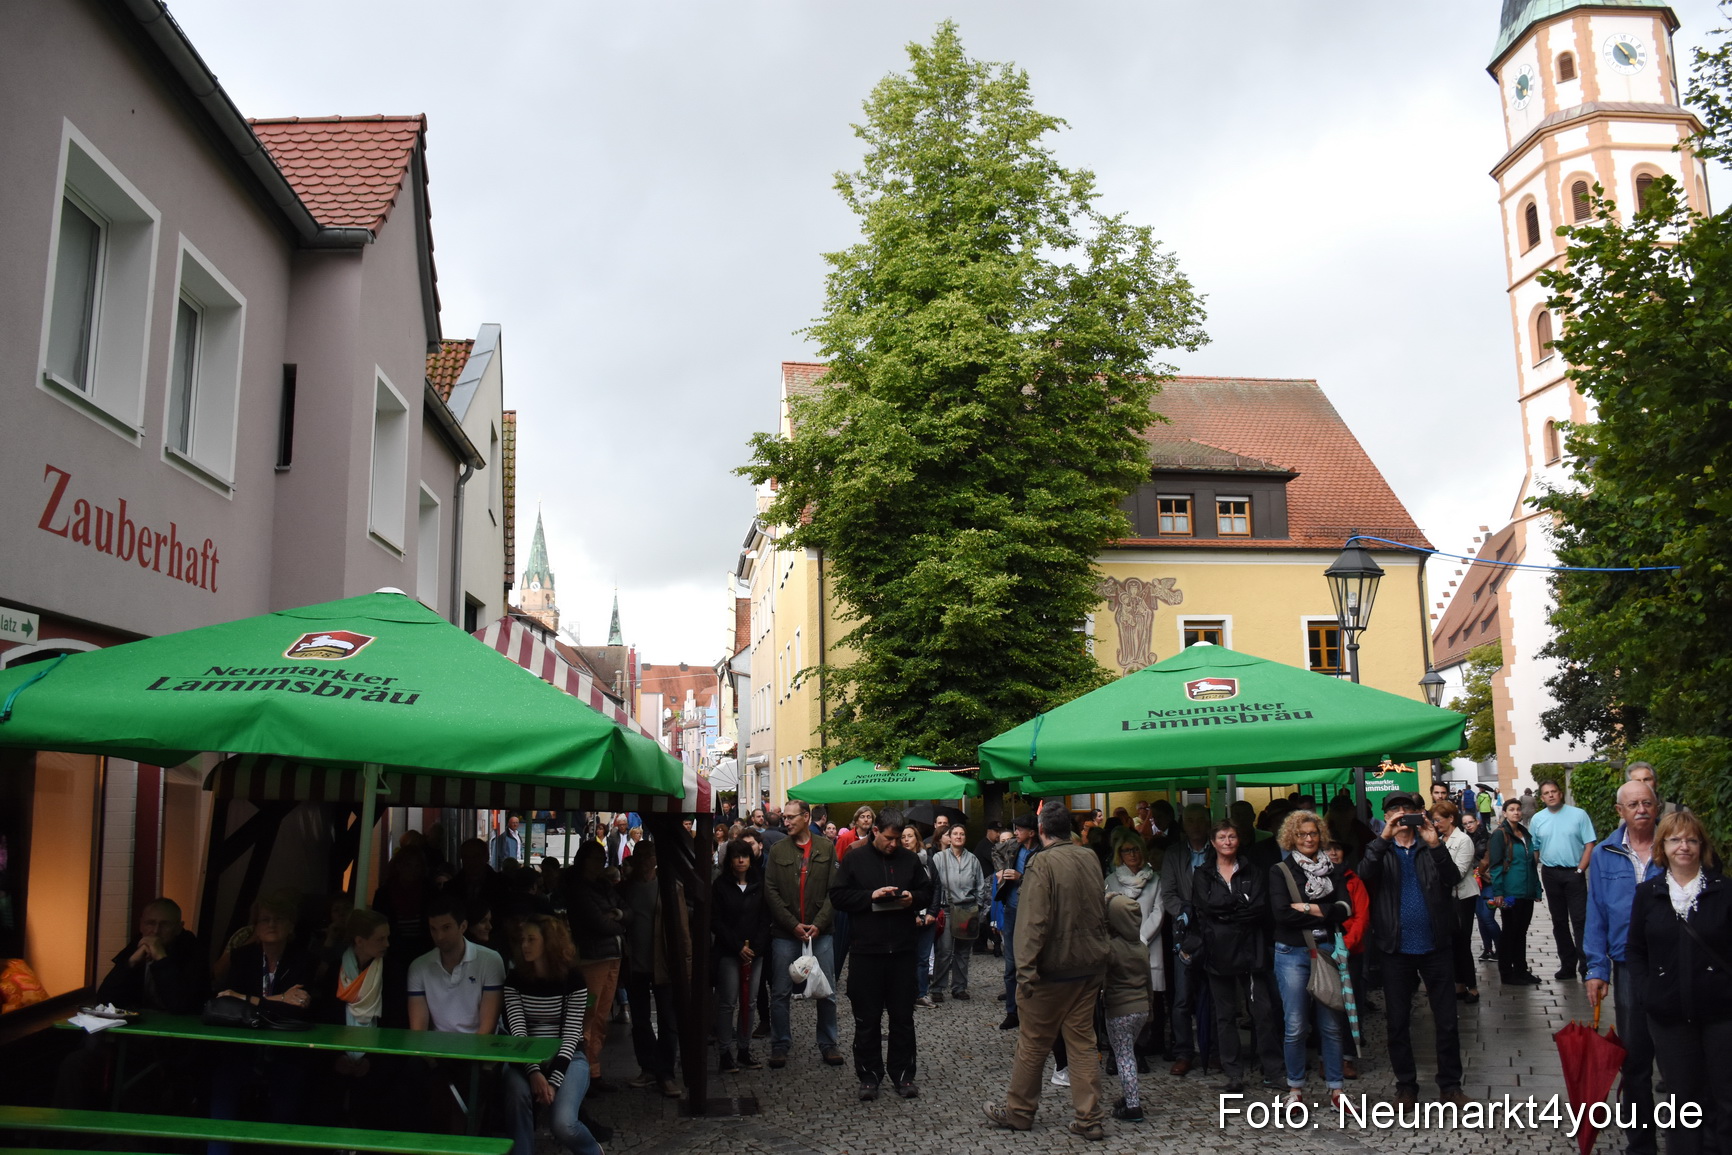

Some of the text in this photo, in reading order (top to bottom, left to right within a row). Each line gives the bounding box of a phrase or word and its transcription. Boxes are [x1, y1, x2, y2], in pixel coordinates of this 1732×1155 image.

[39, 465, 220, 593] Zauberhaft
[203, 666, 398, 686] Neumarkter
[145, 676, 420, 706] Lammsbräu
[1148, 702, 1285, 718] Neumarkter
[1122, 710, 1314, 731] Lammsbräu
[843, 776, 915, 785] Lammsbräu
